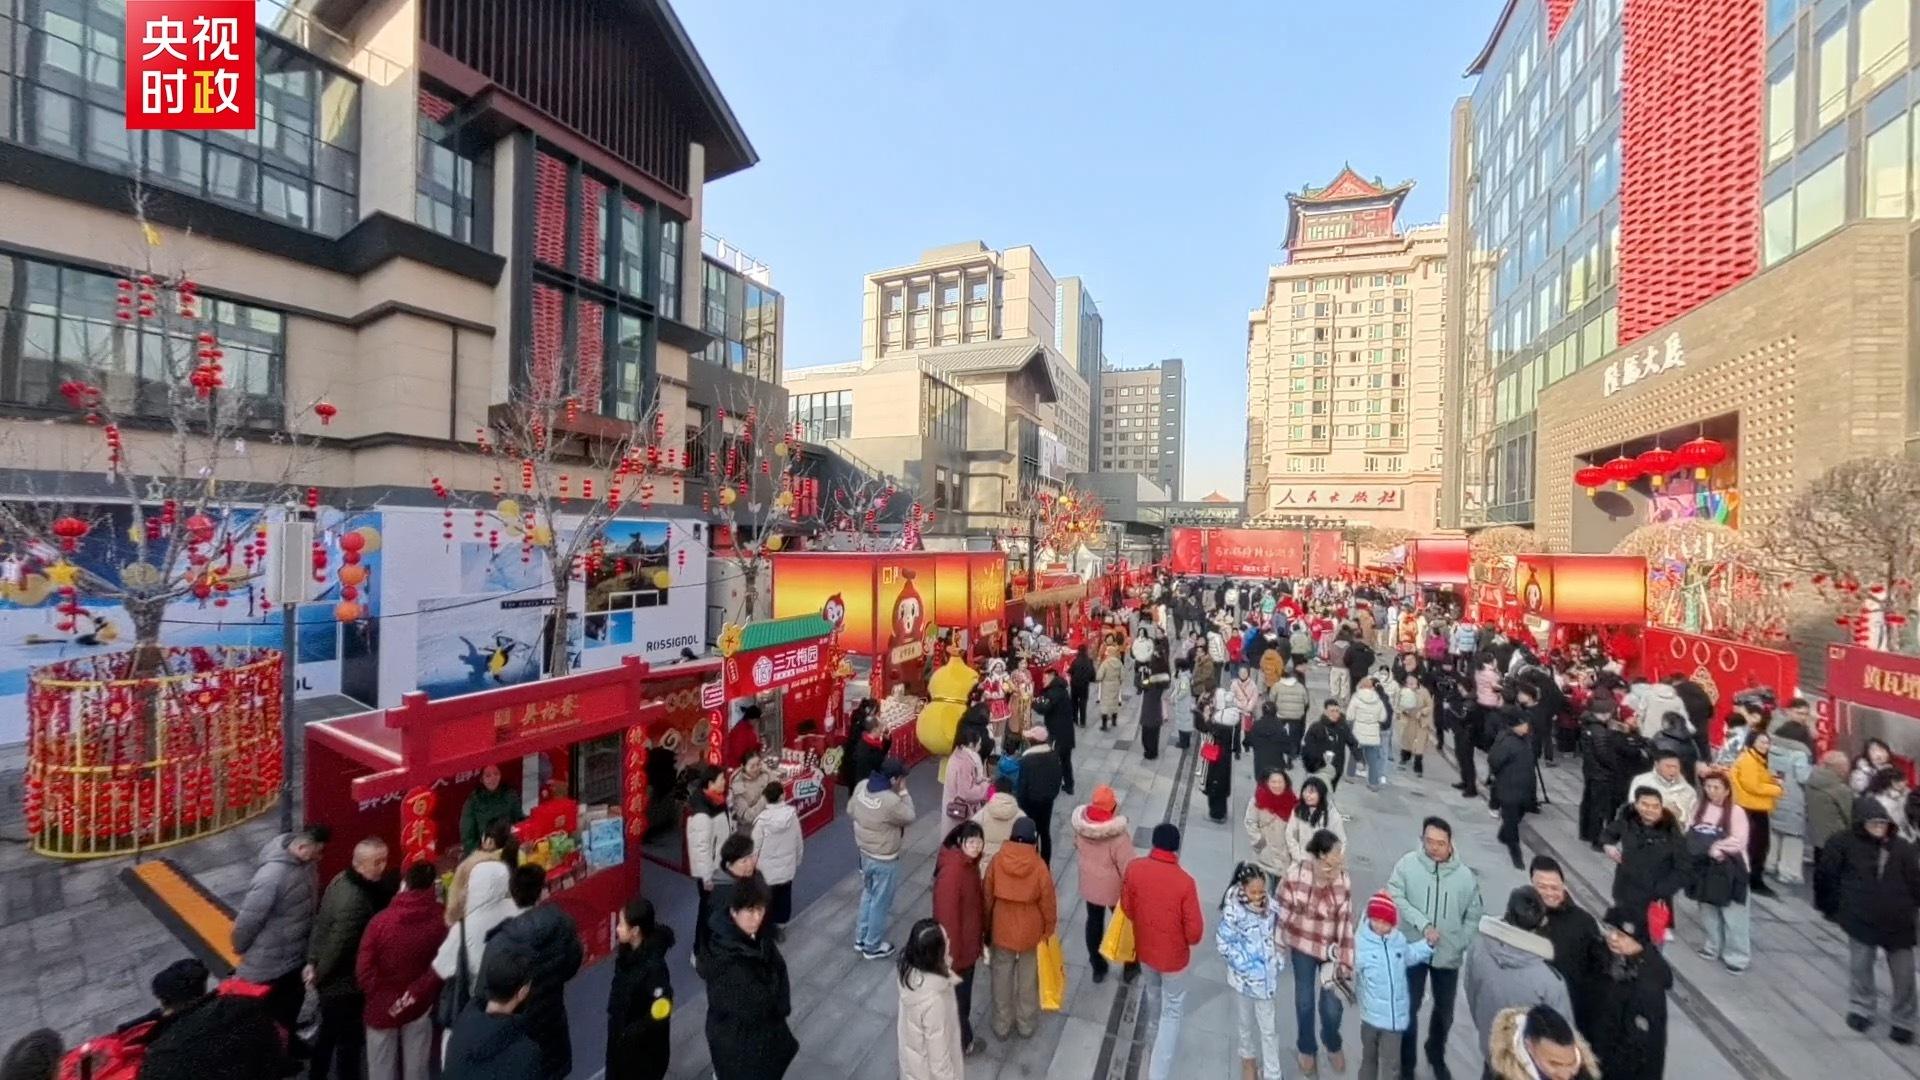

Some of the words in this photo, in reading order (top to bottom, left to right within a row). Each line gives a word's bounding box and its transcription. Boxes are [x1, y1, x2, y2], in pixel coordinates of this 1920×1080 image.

[1276, 488, 1396, 505] 人民出版社
[646, 634, 699, 653] ROSSIGNOL
[773, 645, 818, 671] 三元梅园
